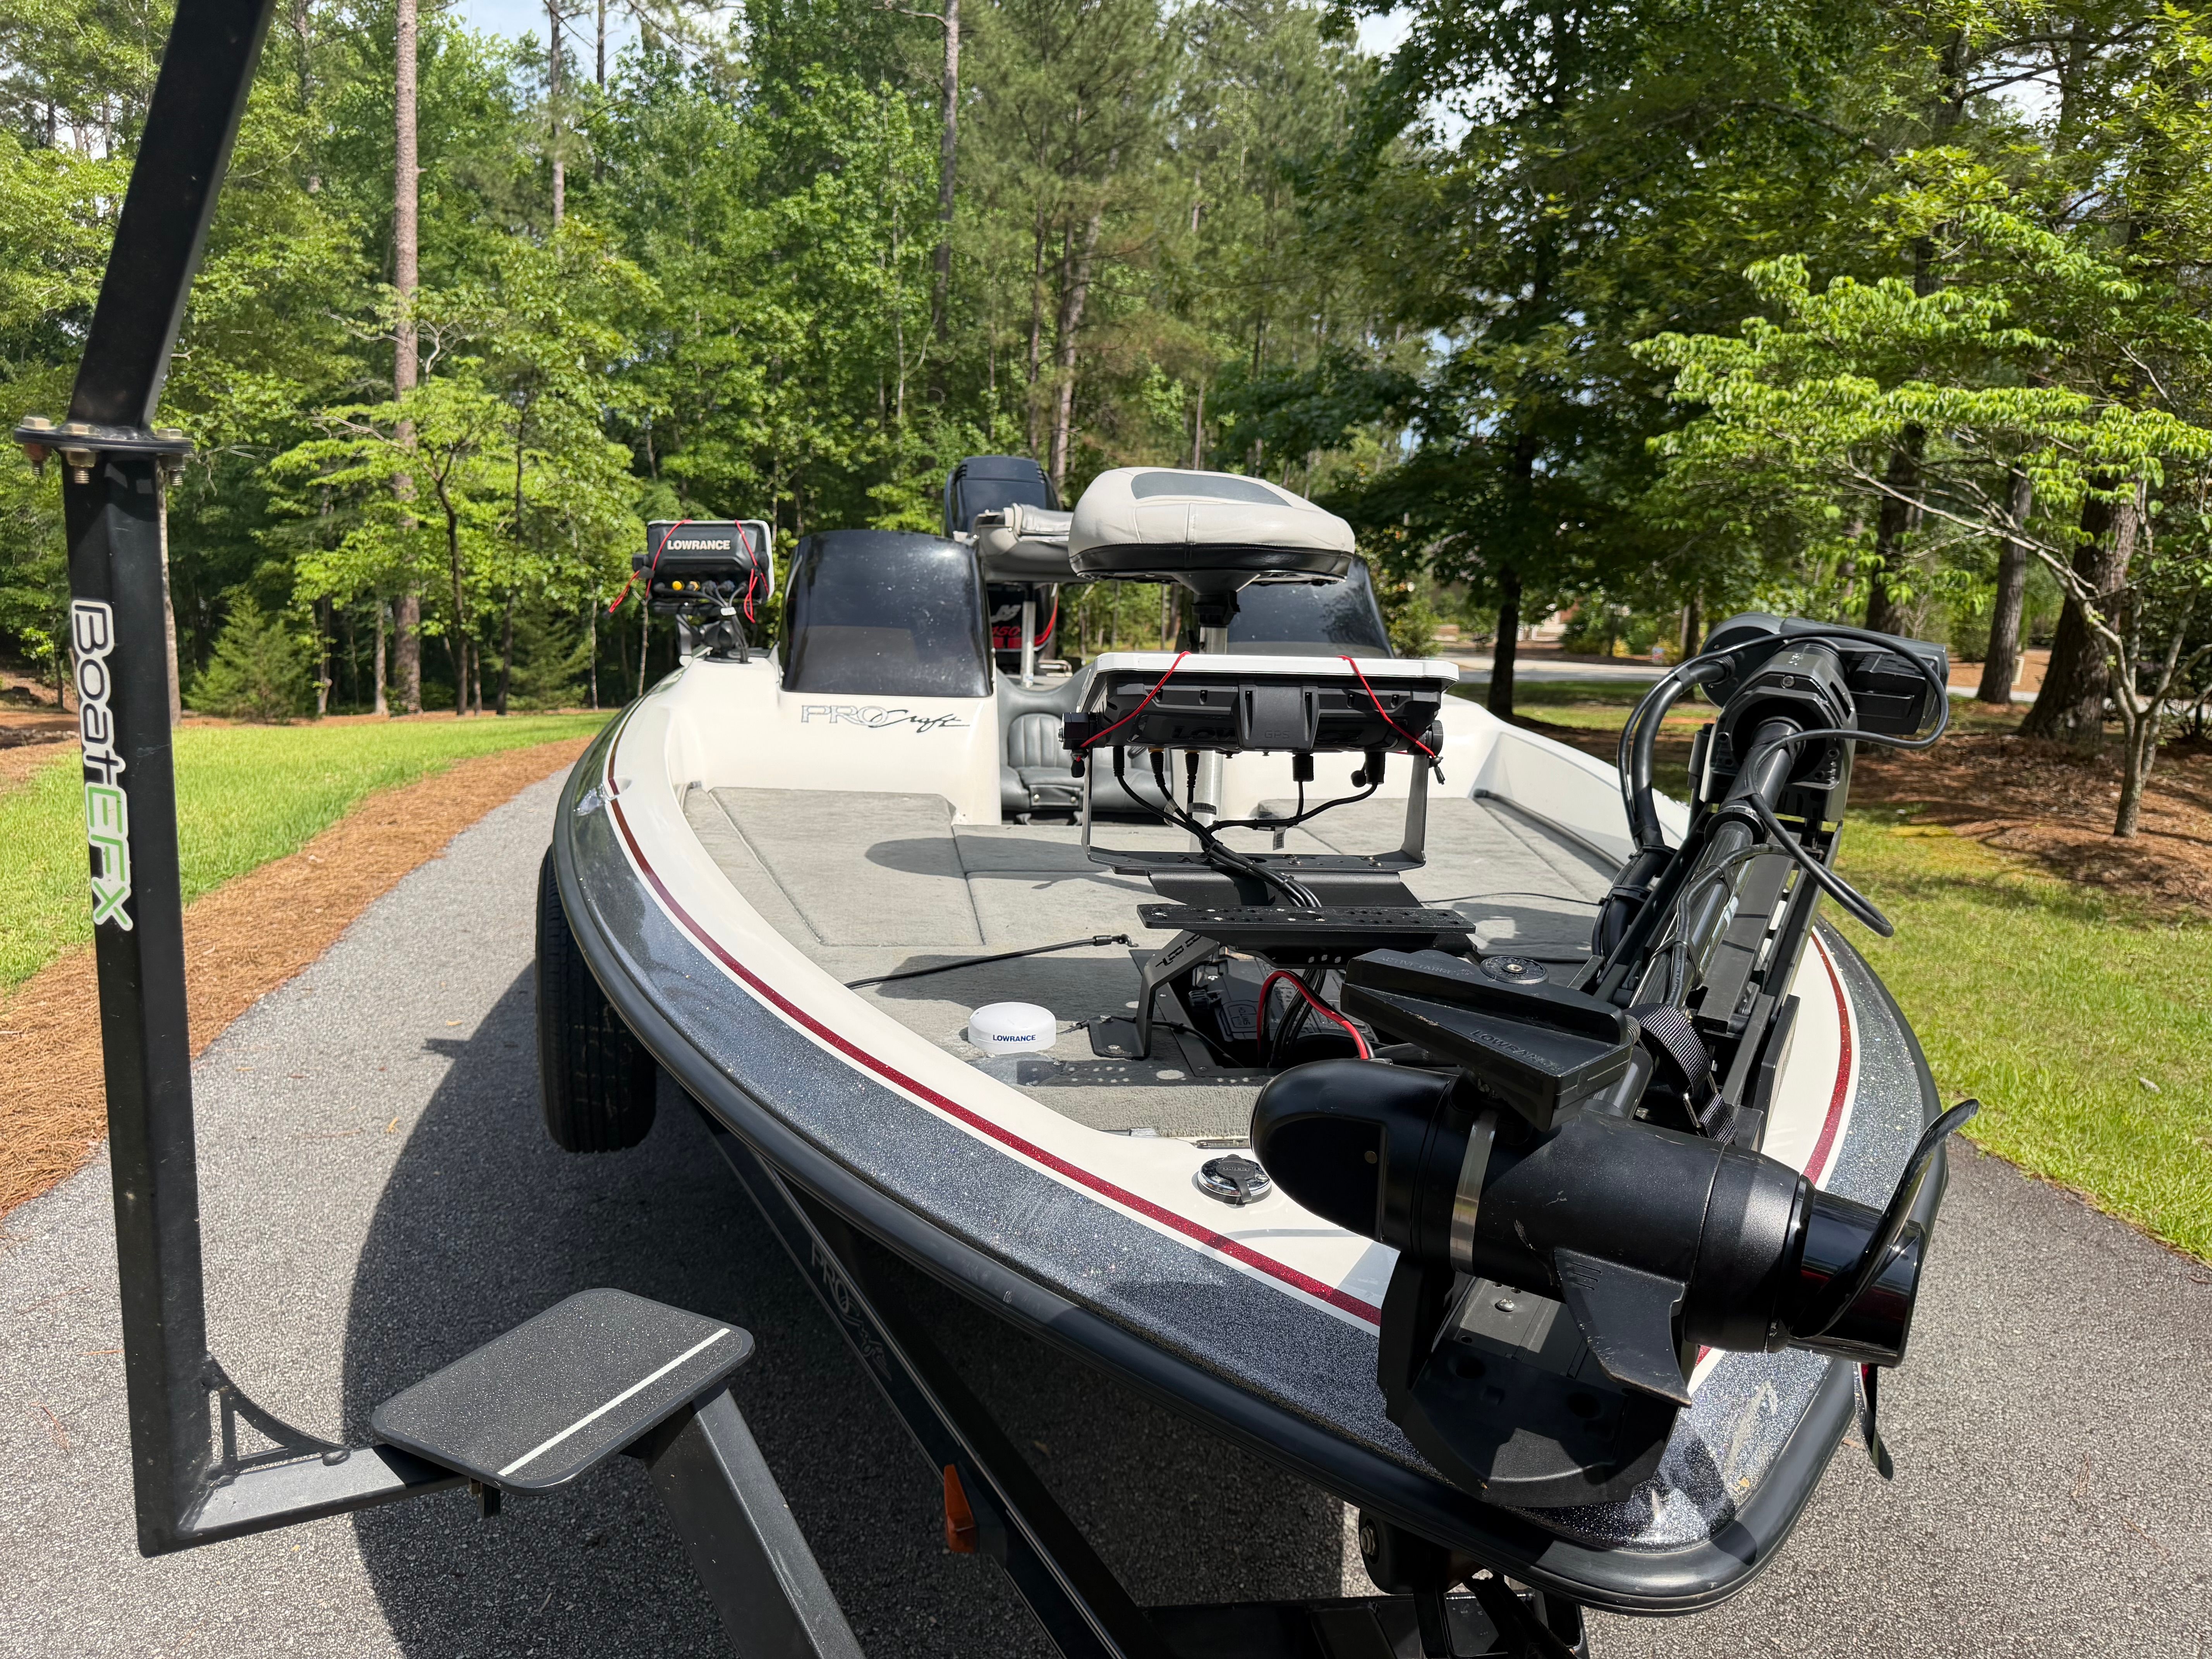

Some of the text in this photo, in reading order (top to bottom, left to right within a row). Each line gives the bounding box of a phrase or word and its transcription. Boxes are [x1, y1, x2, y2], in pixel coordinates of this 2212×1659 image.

[668, 540, 731, 550] LOWRANCE
[992, 626, 1022, 636] 150
[1264, 730, 1290, 739] GPS
[72, 600, 134, 932] BoatEFX
